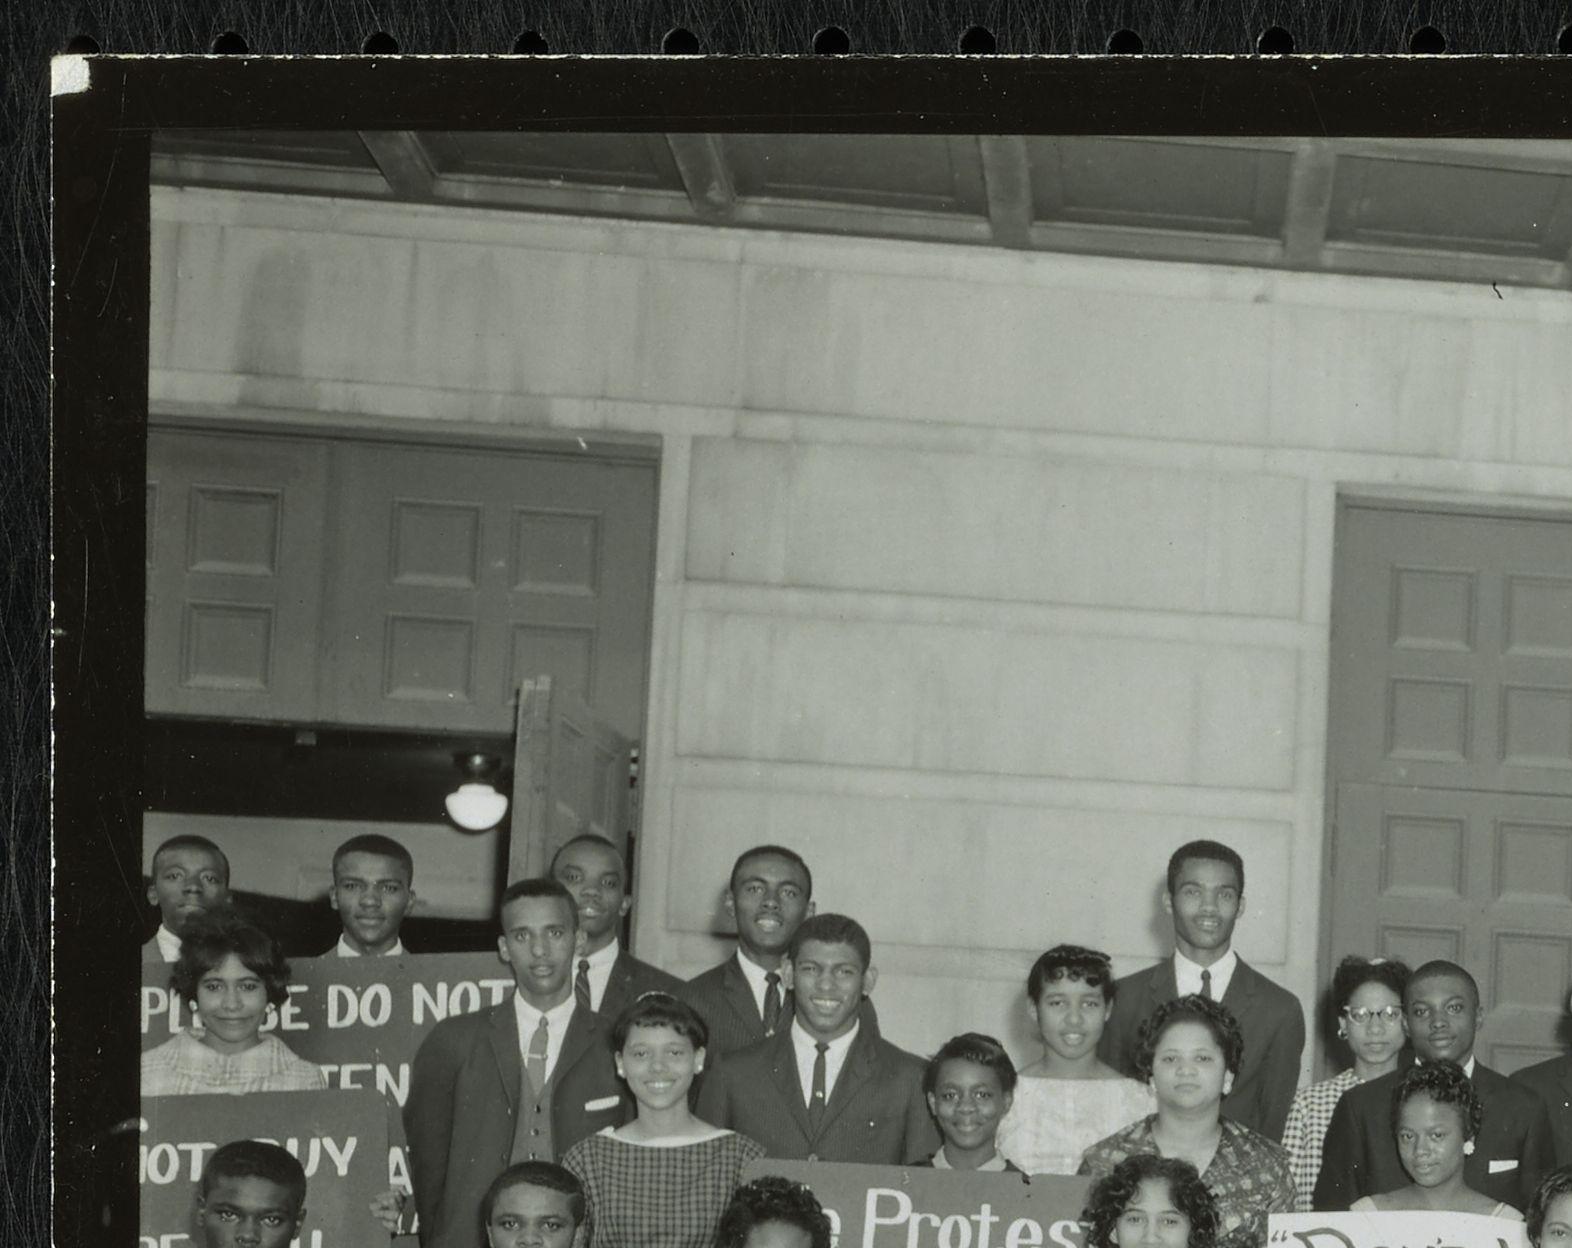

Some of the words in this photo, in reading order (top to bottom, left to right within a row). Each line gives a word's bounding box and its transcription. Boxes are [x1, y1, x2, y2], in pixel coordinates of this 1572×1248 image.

[327, 983, 392, 1029] DO
[412, 978, 516, 1025] NOT
[252, 1136, 358, 1178] UY
